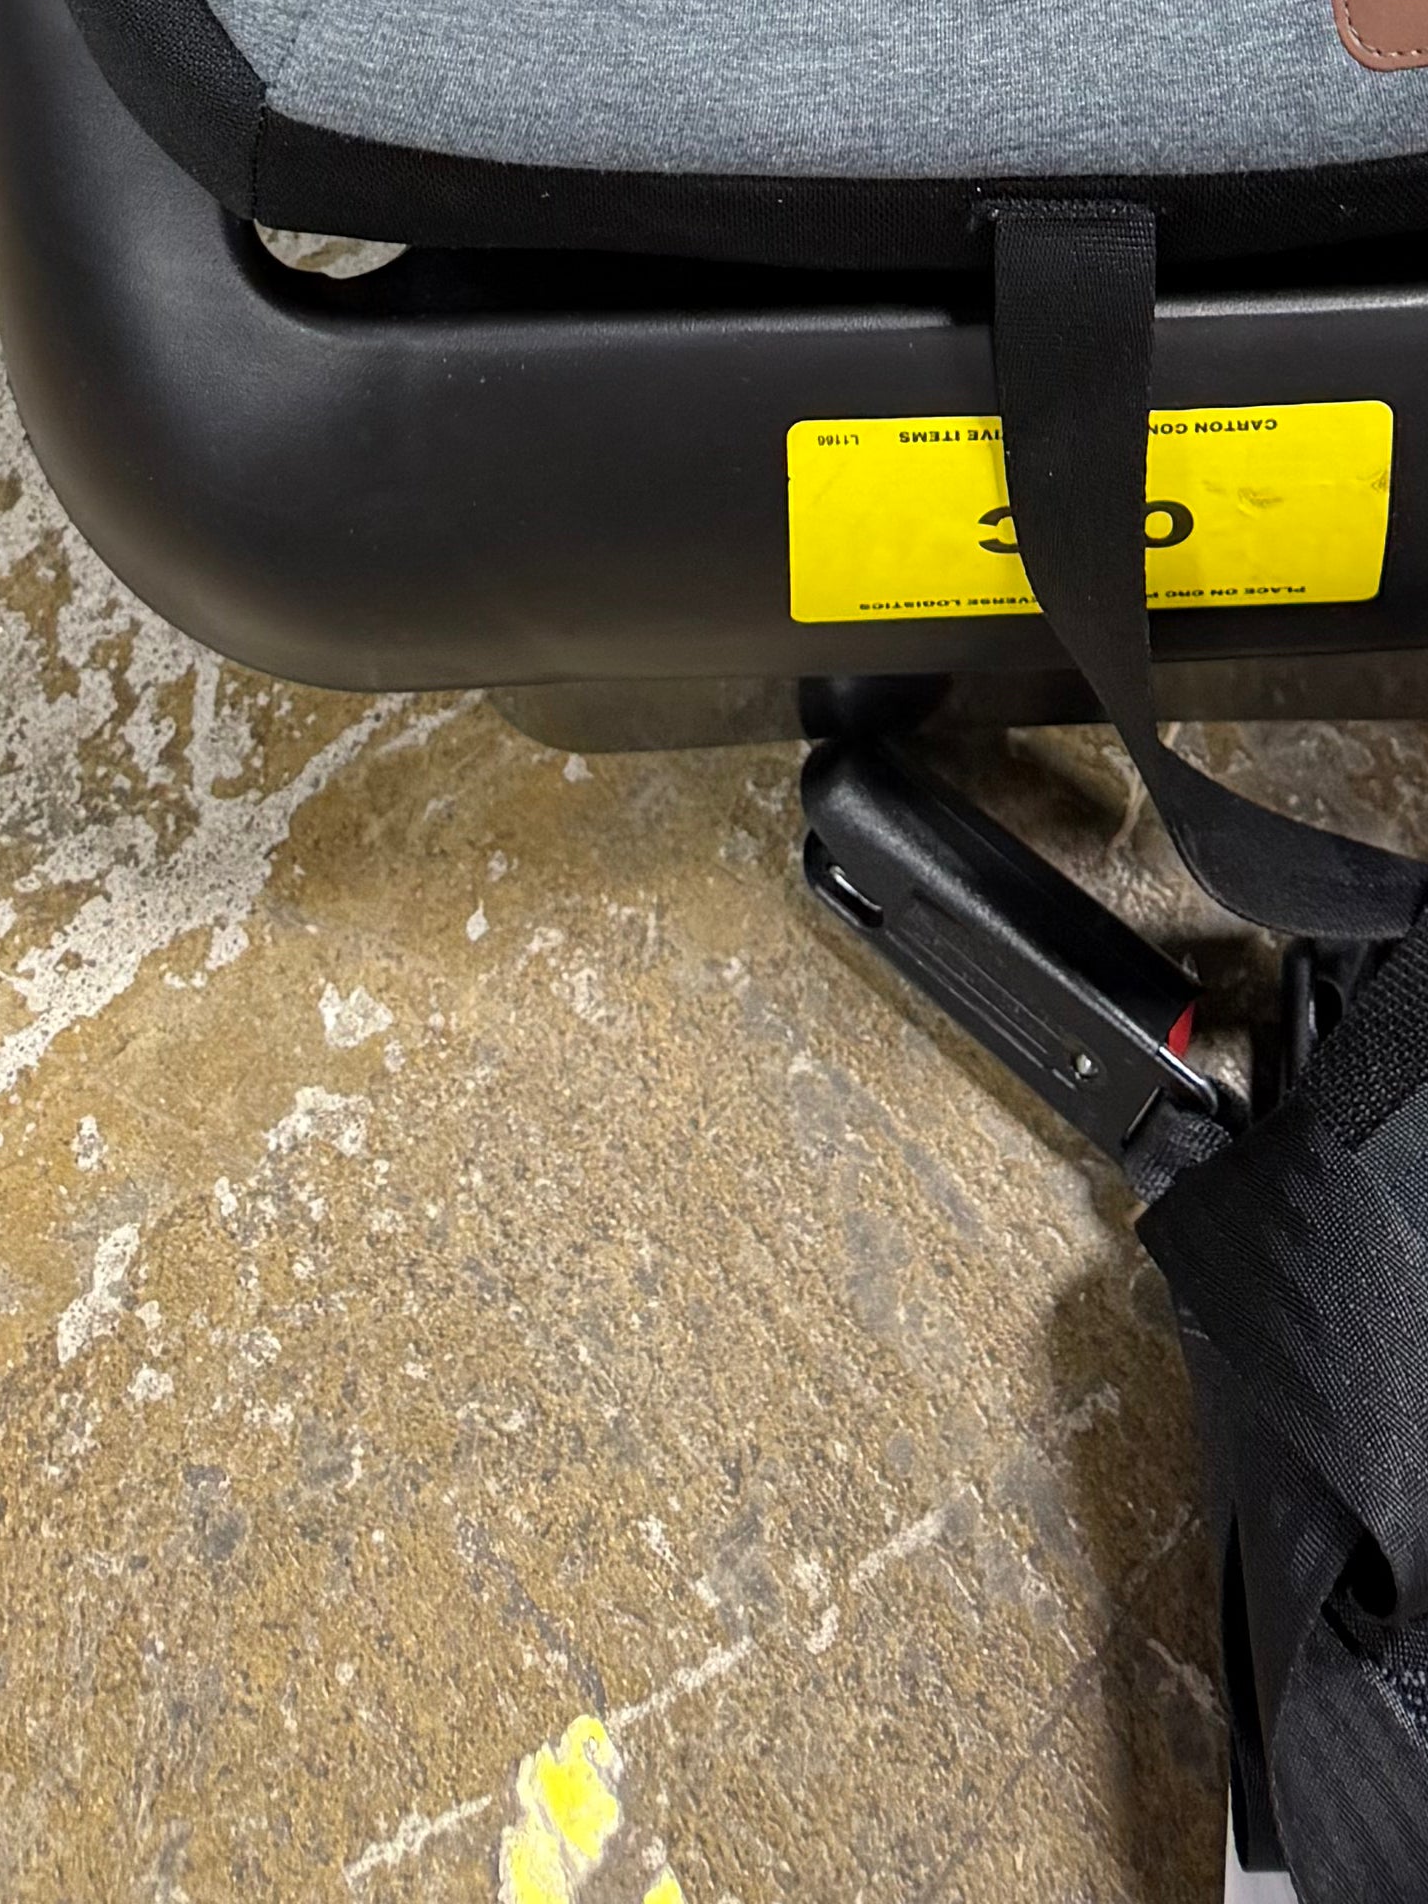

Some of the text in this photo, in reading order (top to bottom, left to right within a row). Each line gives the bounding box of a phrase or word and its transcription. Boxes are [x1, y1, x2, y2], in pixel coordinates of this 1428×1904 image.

[1194, 419, 1278, 434] CARTON
[899, 430, 961, 443] ITEMS
[1244, 586, 1306, 595] PLACE
[859, 599, 962, 611] LOGISTICS
